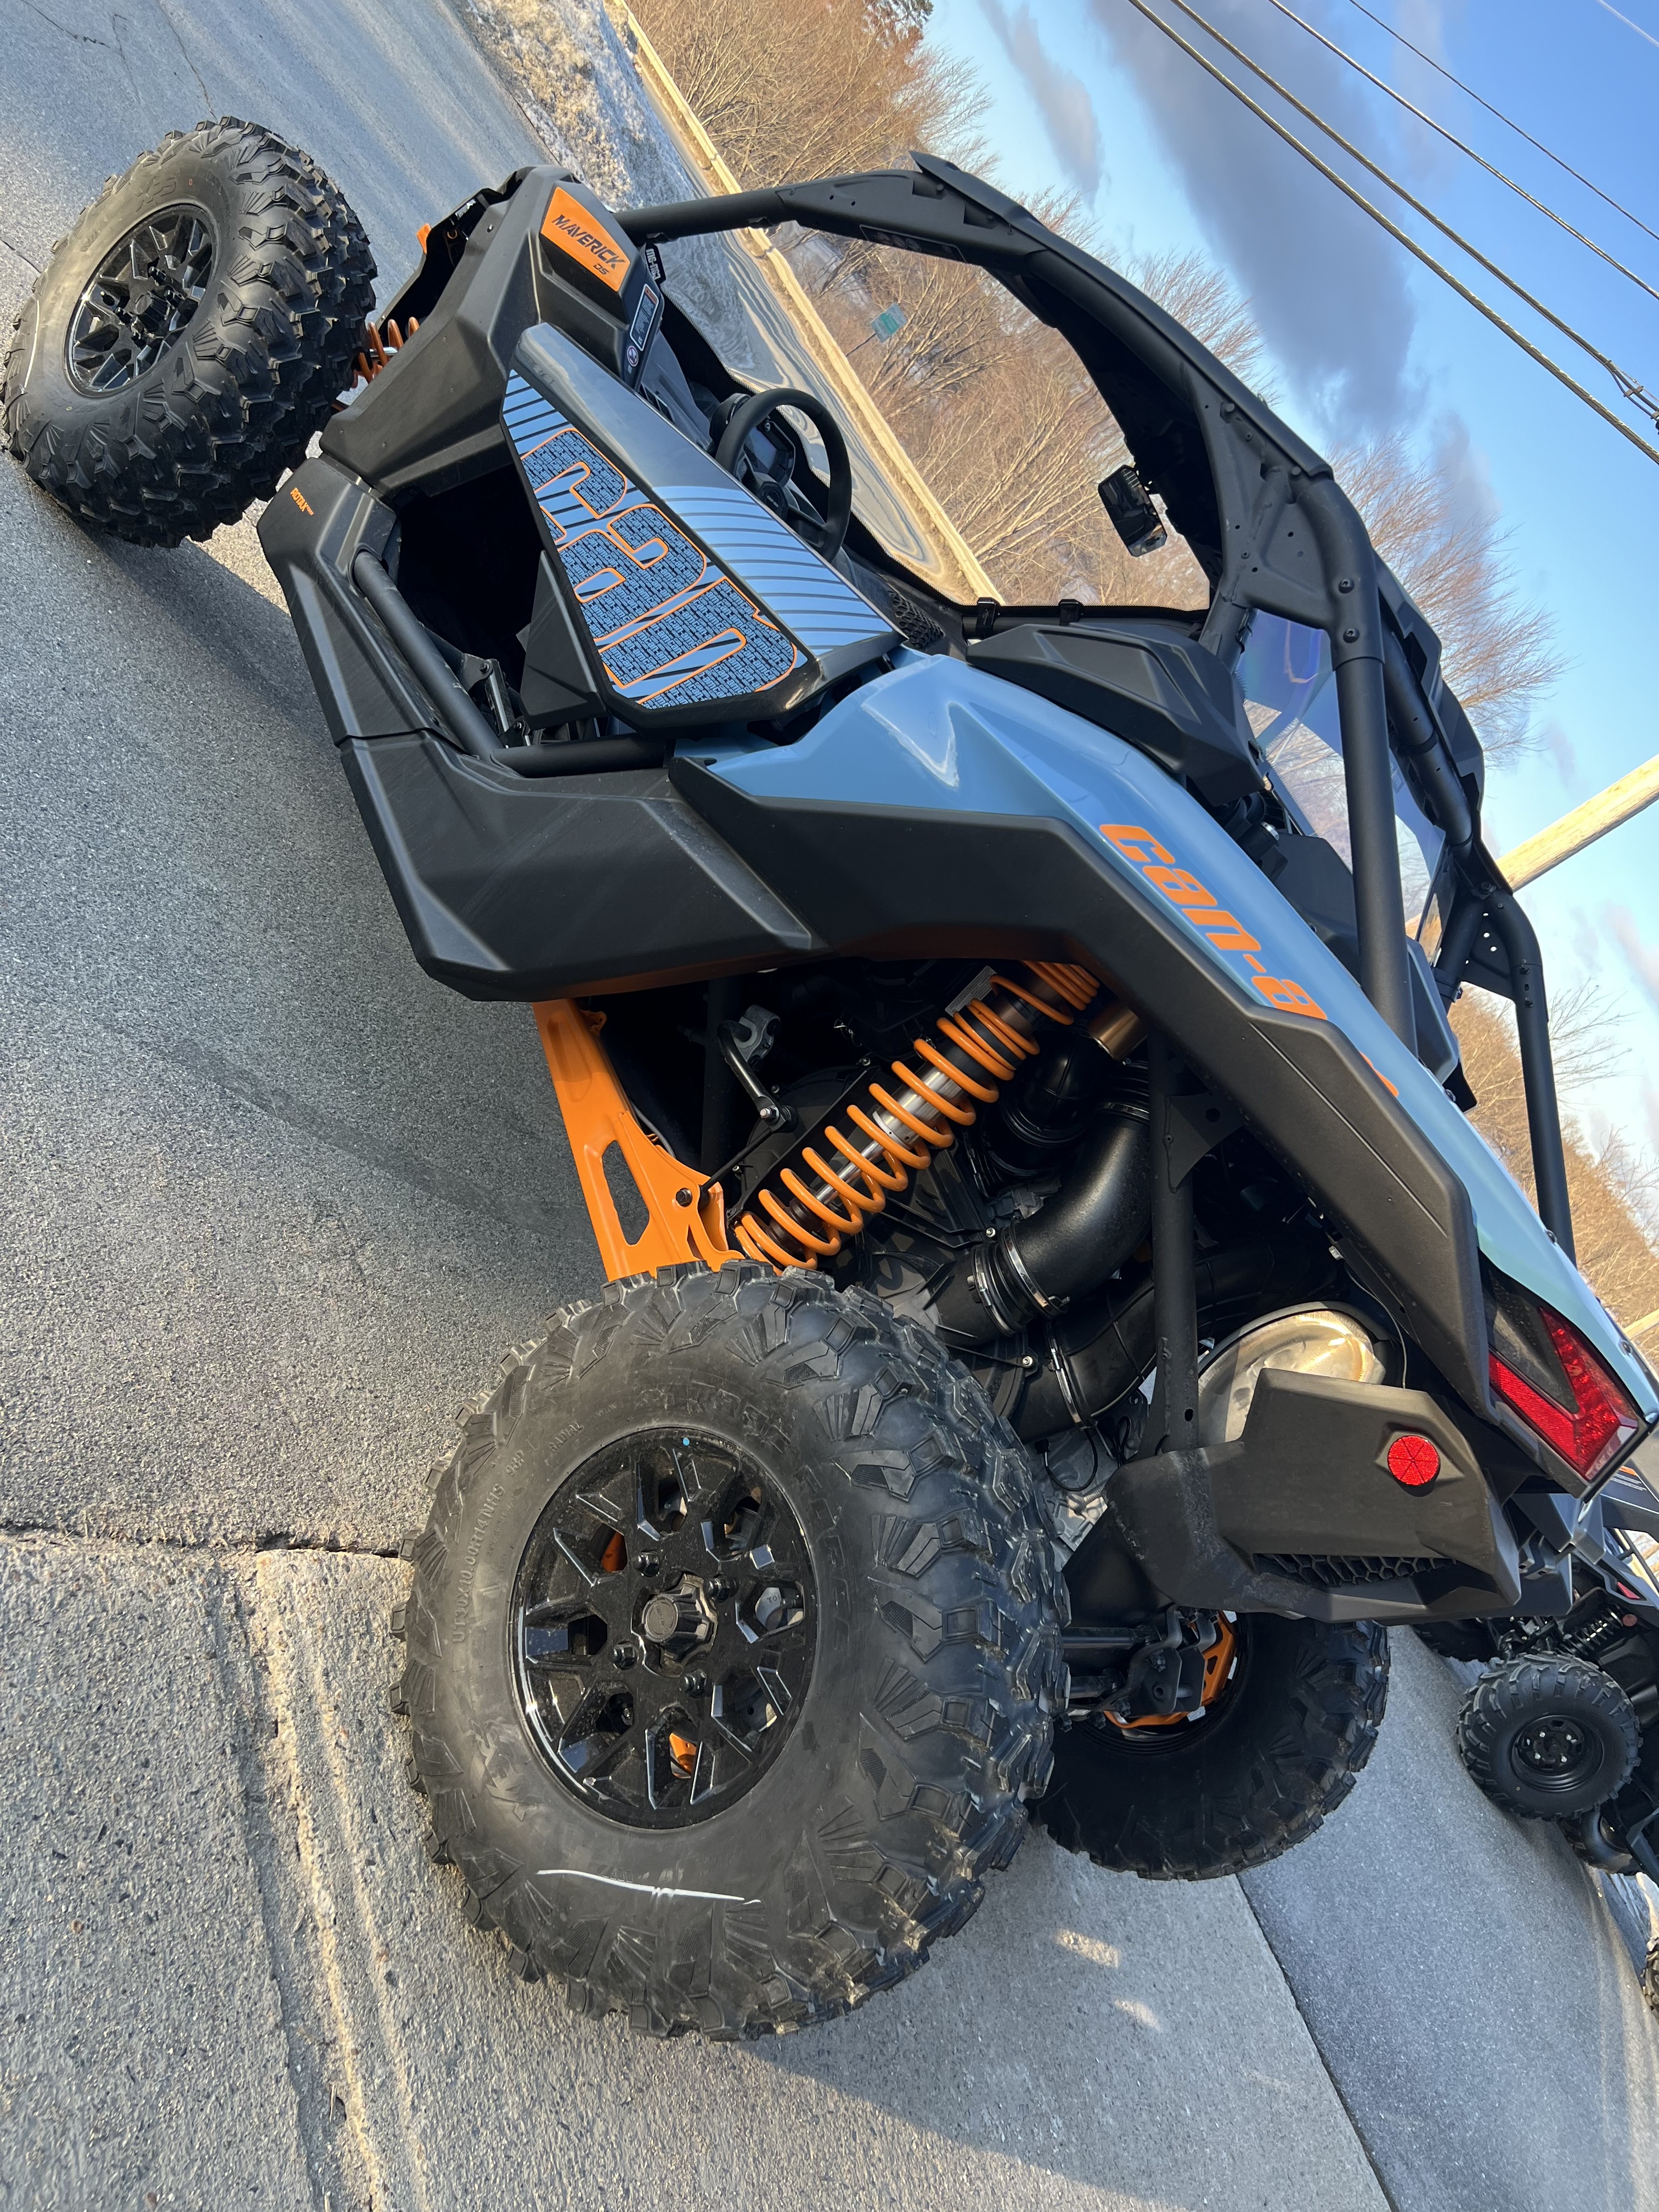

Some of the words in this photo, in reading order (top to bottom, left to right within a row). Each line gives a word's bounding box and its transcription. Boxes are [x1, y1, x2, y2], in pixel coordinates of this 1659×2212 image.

[551, 215, 625, 269] MAVERICK
[593, 263, 610, 275] DS
[290, 487, 308, 512] ROTAX
[549, 1421, 584, 1452] RADIAL
[481, 1483, 505, 1519] NHS
